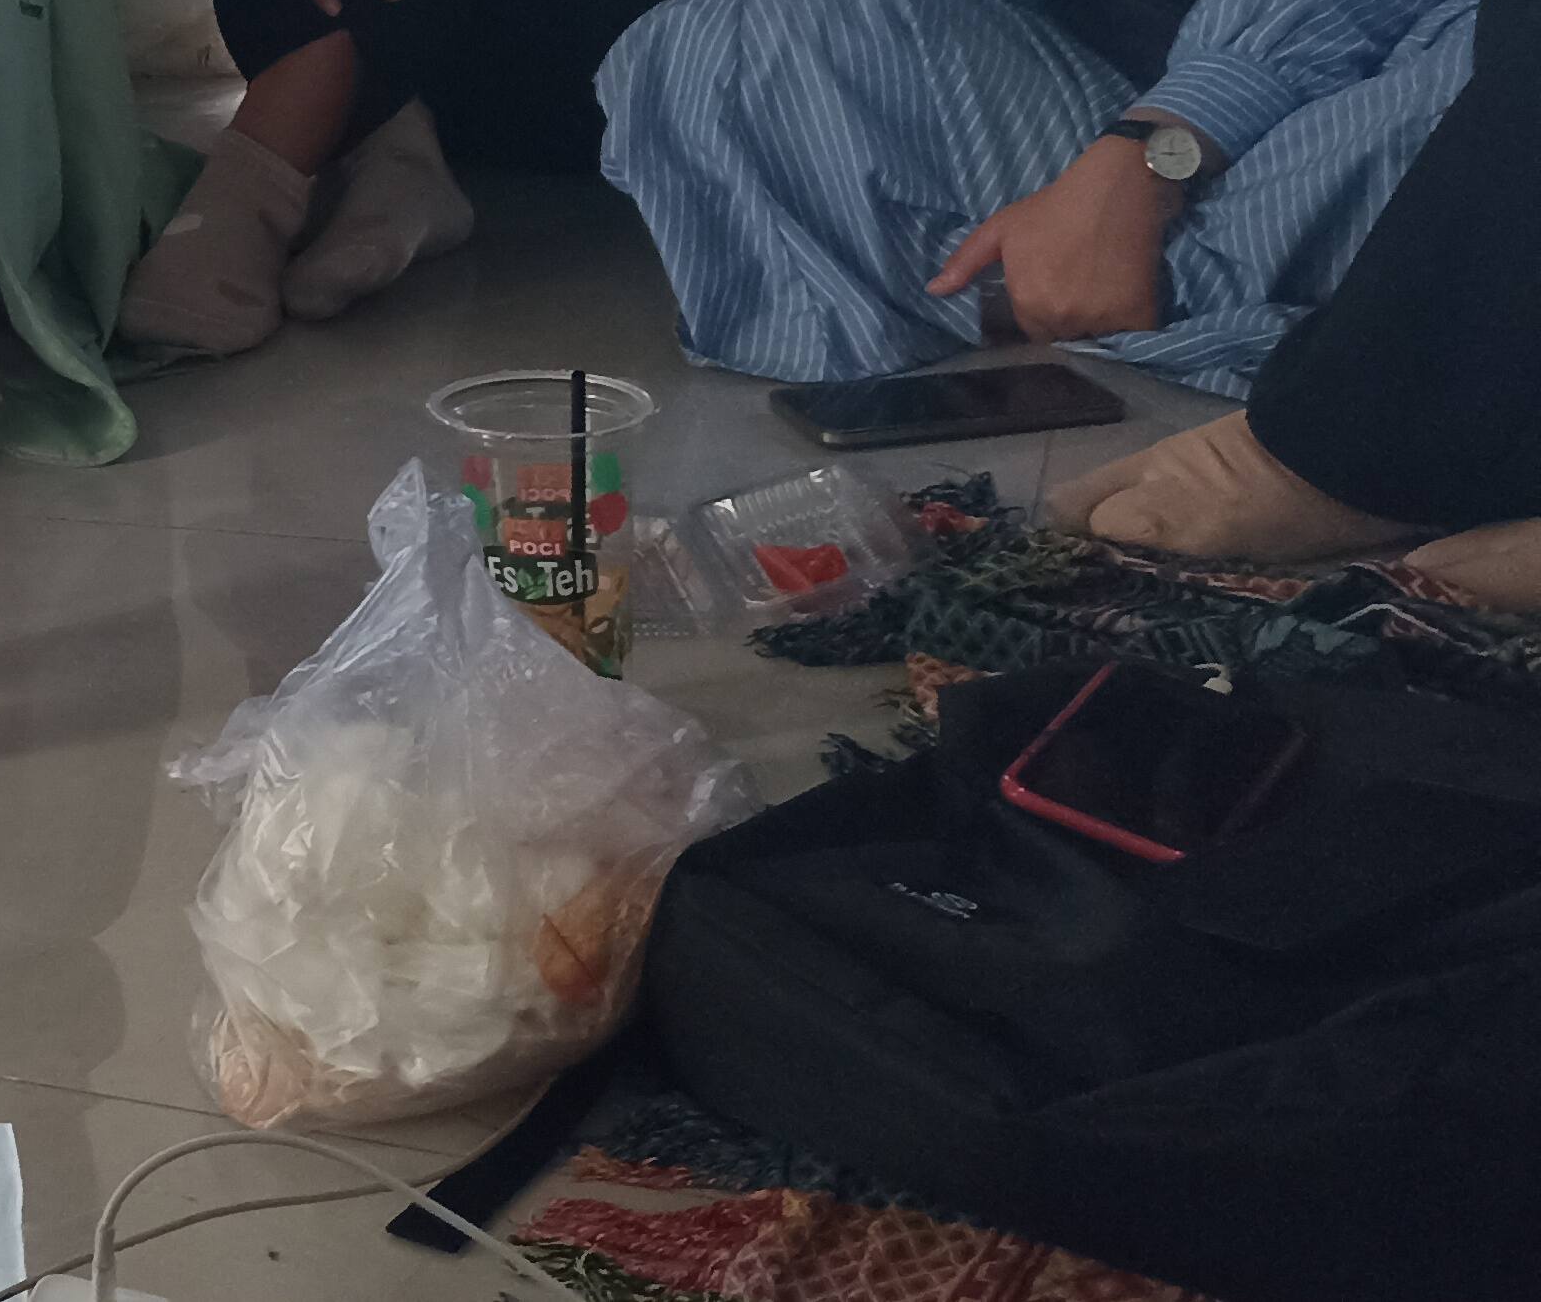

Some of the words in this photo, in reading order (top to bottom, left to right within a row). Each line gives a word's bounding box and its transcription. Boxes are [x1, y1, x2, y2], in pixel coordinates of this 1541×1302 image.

[509, 540, 561, 556] POCI
[487, 556, 519, 594] Es
[536, 559, 594, 597] Teh
